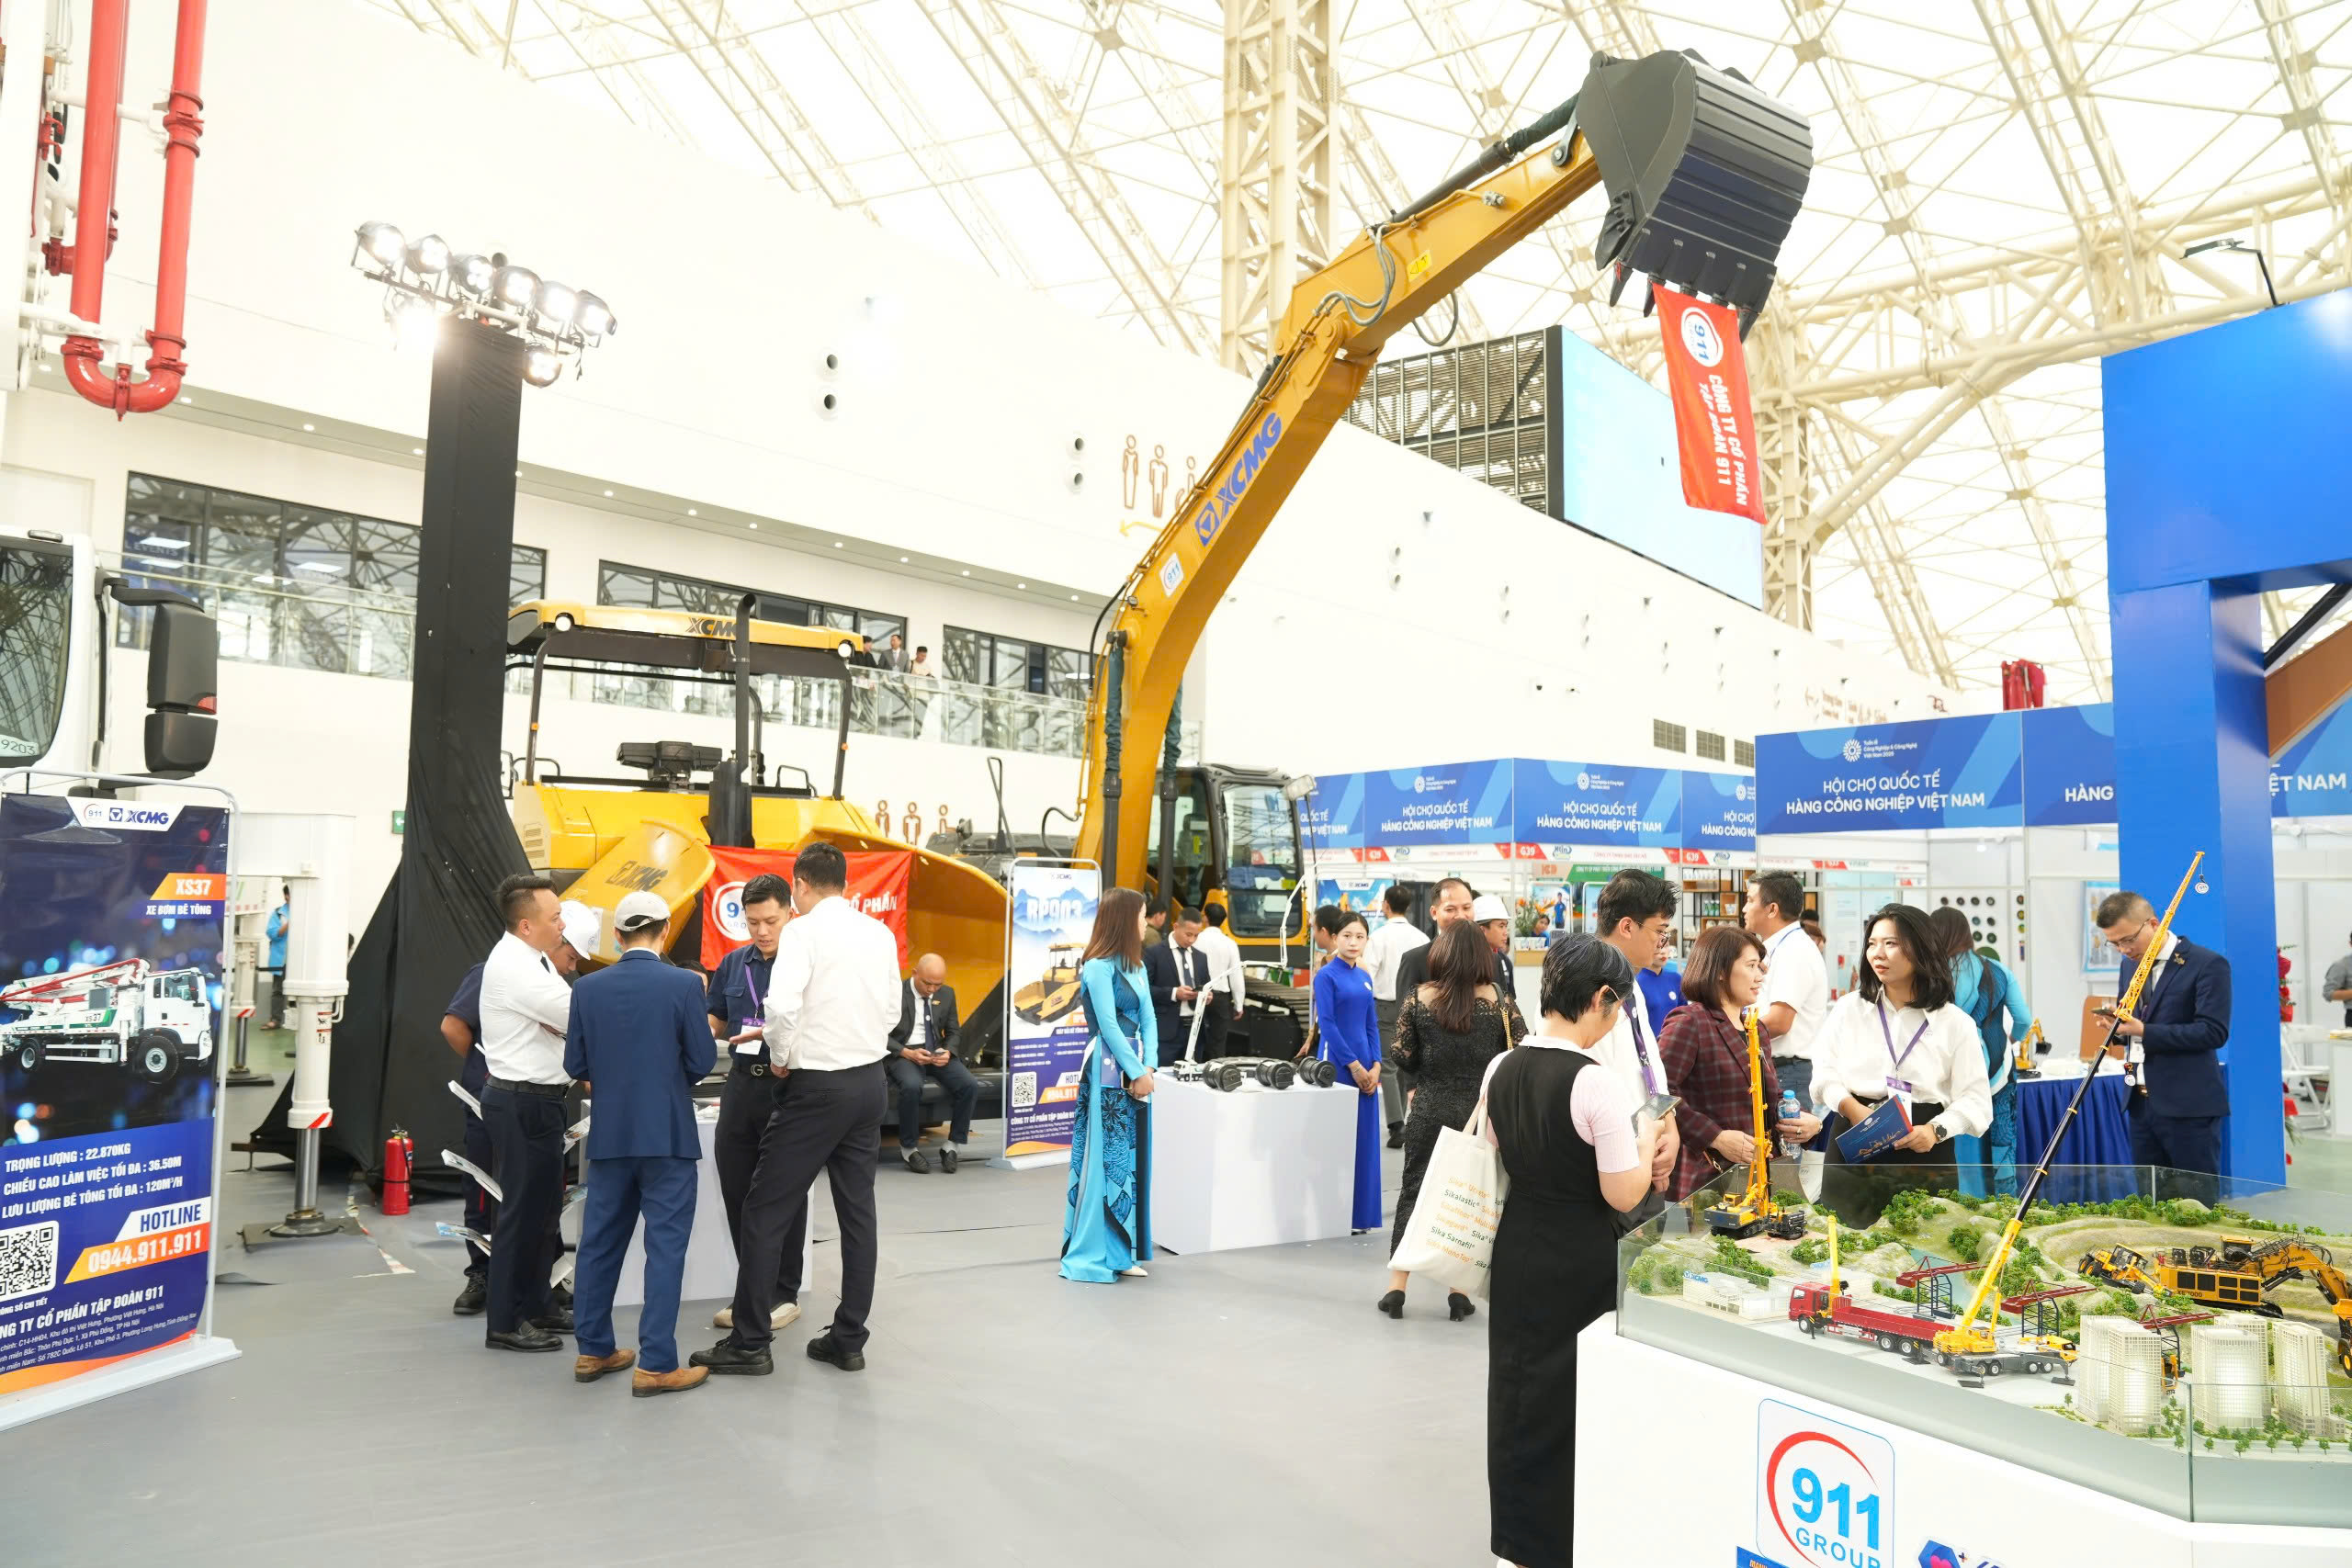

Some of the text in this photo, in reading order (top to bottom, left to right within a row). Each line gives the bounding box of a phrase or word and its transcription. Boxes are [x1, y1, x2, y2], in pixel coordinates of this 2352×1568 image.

[1721, 417, 1737, 434] TY
[1214, 412, 1282, 522] XCMG
[1715, 457, 1732, 485] 911
[1, 739, 35, 756] 9203
[1823, 768, 1940, 795] HỘI CHỢ QUỐC TẾ
[2269, 772, 2346, 797] ỆT NAM
[2064, 783, 2113, 803] HÀNG
[1402, 799, 1469, 818] HỘI CHỢ QUỐC TẾ
[1564, 801, 1637, 816] HỘI CHỢ QUỐC TẾ
[1786, 792, 1984, 814] HÀNG CÔNG NGHIỆP VIỆT NAM
[125, 810, 169, 825] XCMG
[1382, 816, 1493, 832] HÀNG CÔNG NGHIỆP VIỆT NAM
[1537, 816, 1662, 834] HÀNG CÔNG NGHIỆP VIỆT NAM
[1724, 810, 1755, 825] HỘI CHỢ
[1702, 825, 1724, 836] HÀNG
[1724, 825, 1747, 838] CÔNG
[175, 878, 212, 896] XS37
[146, 904, 211, 915] XE BƠM BÊ TÔNG
[6, 1156, 40, 1173] TRỌNG
[43, 1150, 77, 1167] LƯỢNG
[85, 1143, 130, 1160] 22.870KG
[4, 1177, 37, 1196] CHIỀU
[39, 1176, 61, 1190] CAO
[62, 1170, 85, 1185] LÀM
[86, 1167, 108, 1183] VIỆC
[110, 1161, 126, 1178] TỐI
[128, 1163, 141, 1174] ĐA
[149, 1156, 182, 1172] 36.50M
[2, 1203, 24, 1219] LƯU
[26, 1198, 61, 1214] LƯỢNG
[62, 1193, 77, 1207] BÊ
[79, 1190, 105, 1205] TÔNG
[107, 1183, 123, 1200] TỐI
[125, 1185, 138, 1196] ĐA
[140, 1203, 202, 1233] HOTLINE
[1431, 1226, 1446, 1237] Sika
[88, 1229, 202, 1273] 0944.911.911
[0, 1285, 164, 1339] NG TY CỔ PHẦN TẬP ĐOÀN 911
[15, 1296, 48, 1312] SỐ CHI TIẾT
[1792, 1467, 1880, 1551] 911
